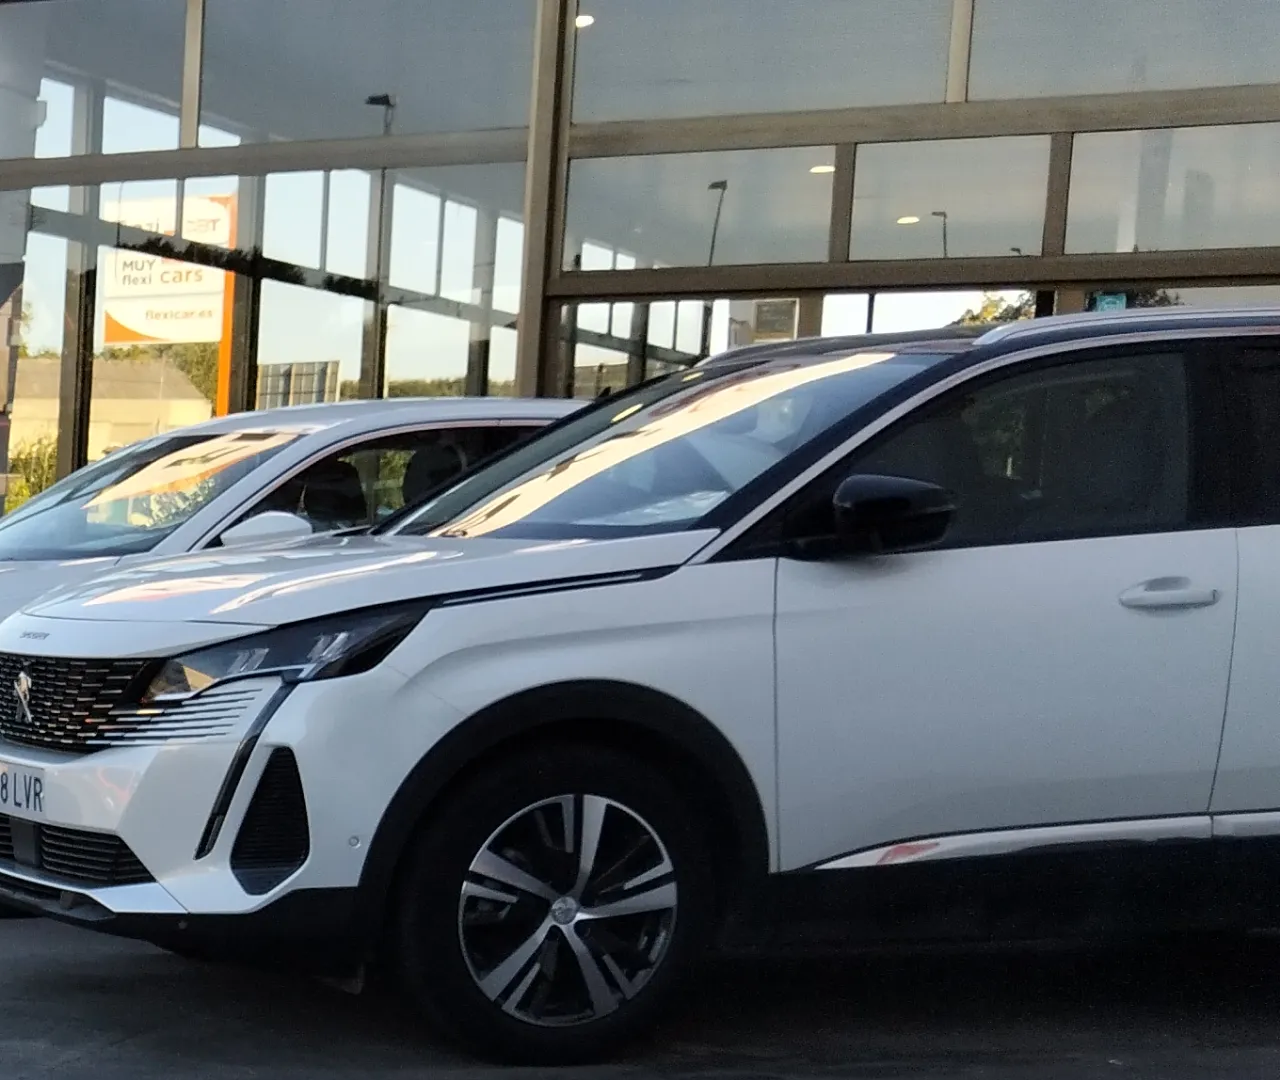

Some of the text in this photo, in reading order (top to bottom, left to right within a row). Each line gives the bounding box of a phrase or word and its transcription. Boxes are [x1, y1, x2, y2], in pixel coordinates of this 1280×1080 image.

[121, 258, 156, 273] MUY
[121, 267, 204, 287] flexi cars
[13, 772, 44, 813] LVR
